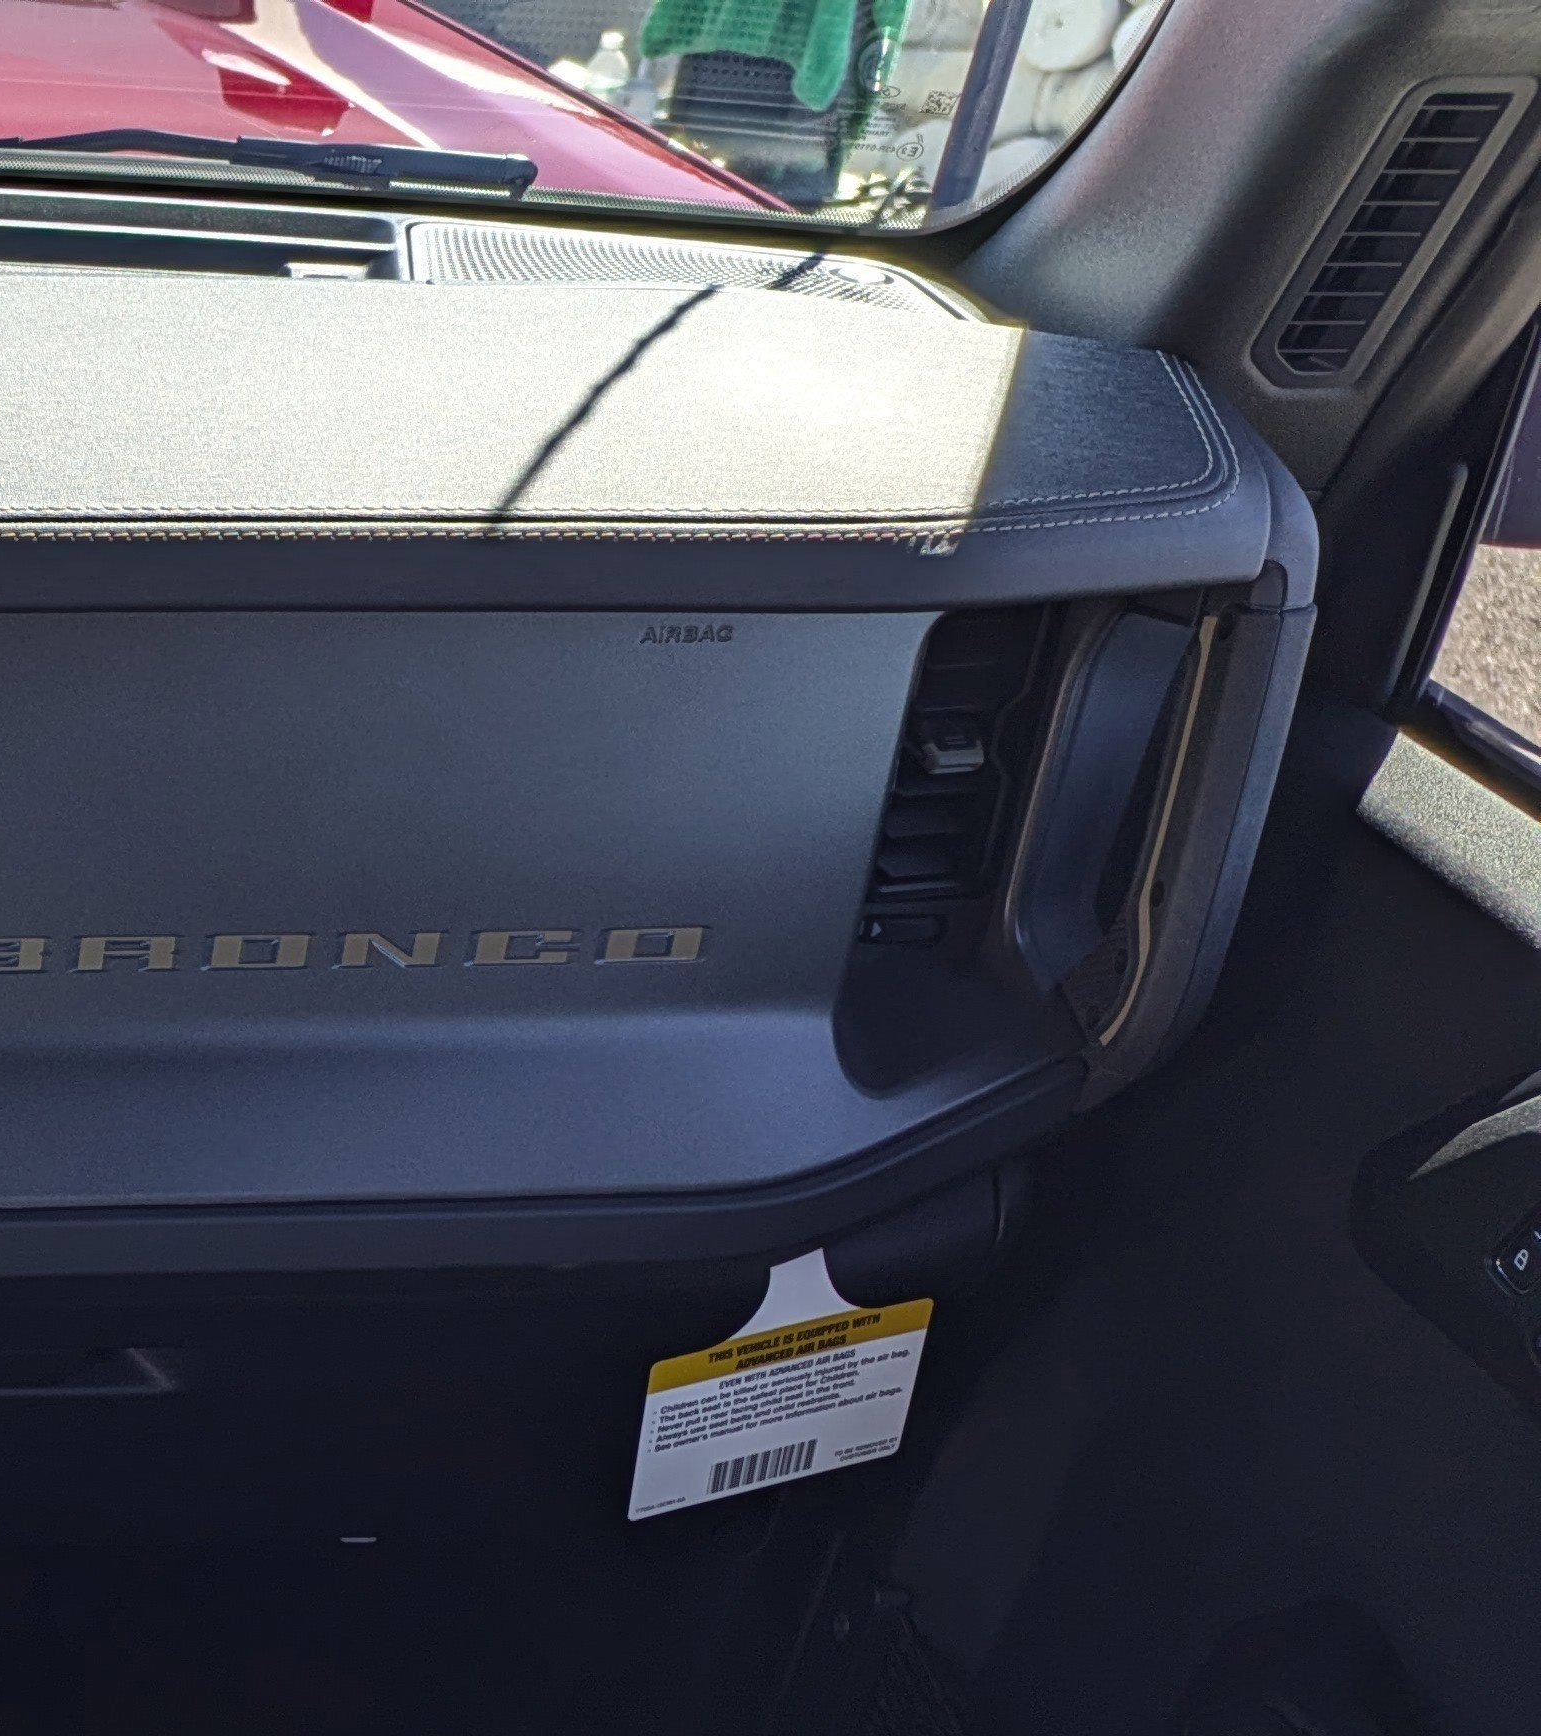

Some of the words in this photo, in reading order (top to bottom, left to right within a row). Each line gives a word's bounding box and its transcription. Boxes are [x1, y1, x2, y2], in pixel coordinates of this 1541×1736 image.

[639, 624, 734, 645] AIRBAG
[737, 1337, 779, 1355] VEHICLE
[783, 1334, 793, 1343] IS
[797, 1320, 848, 1340] EQUIPPED
[852, 1313, 880, 1327] WITH
[736, 1347, 793, 1368] ADVANCED
[796, 1342, 814, 1353] AIR
[818, 1335, 846, 1348] BAGS
